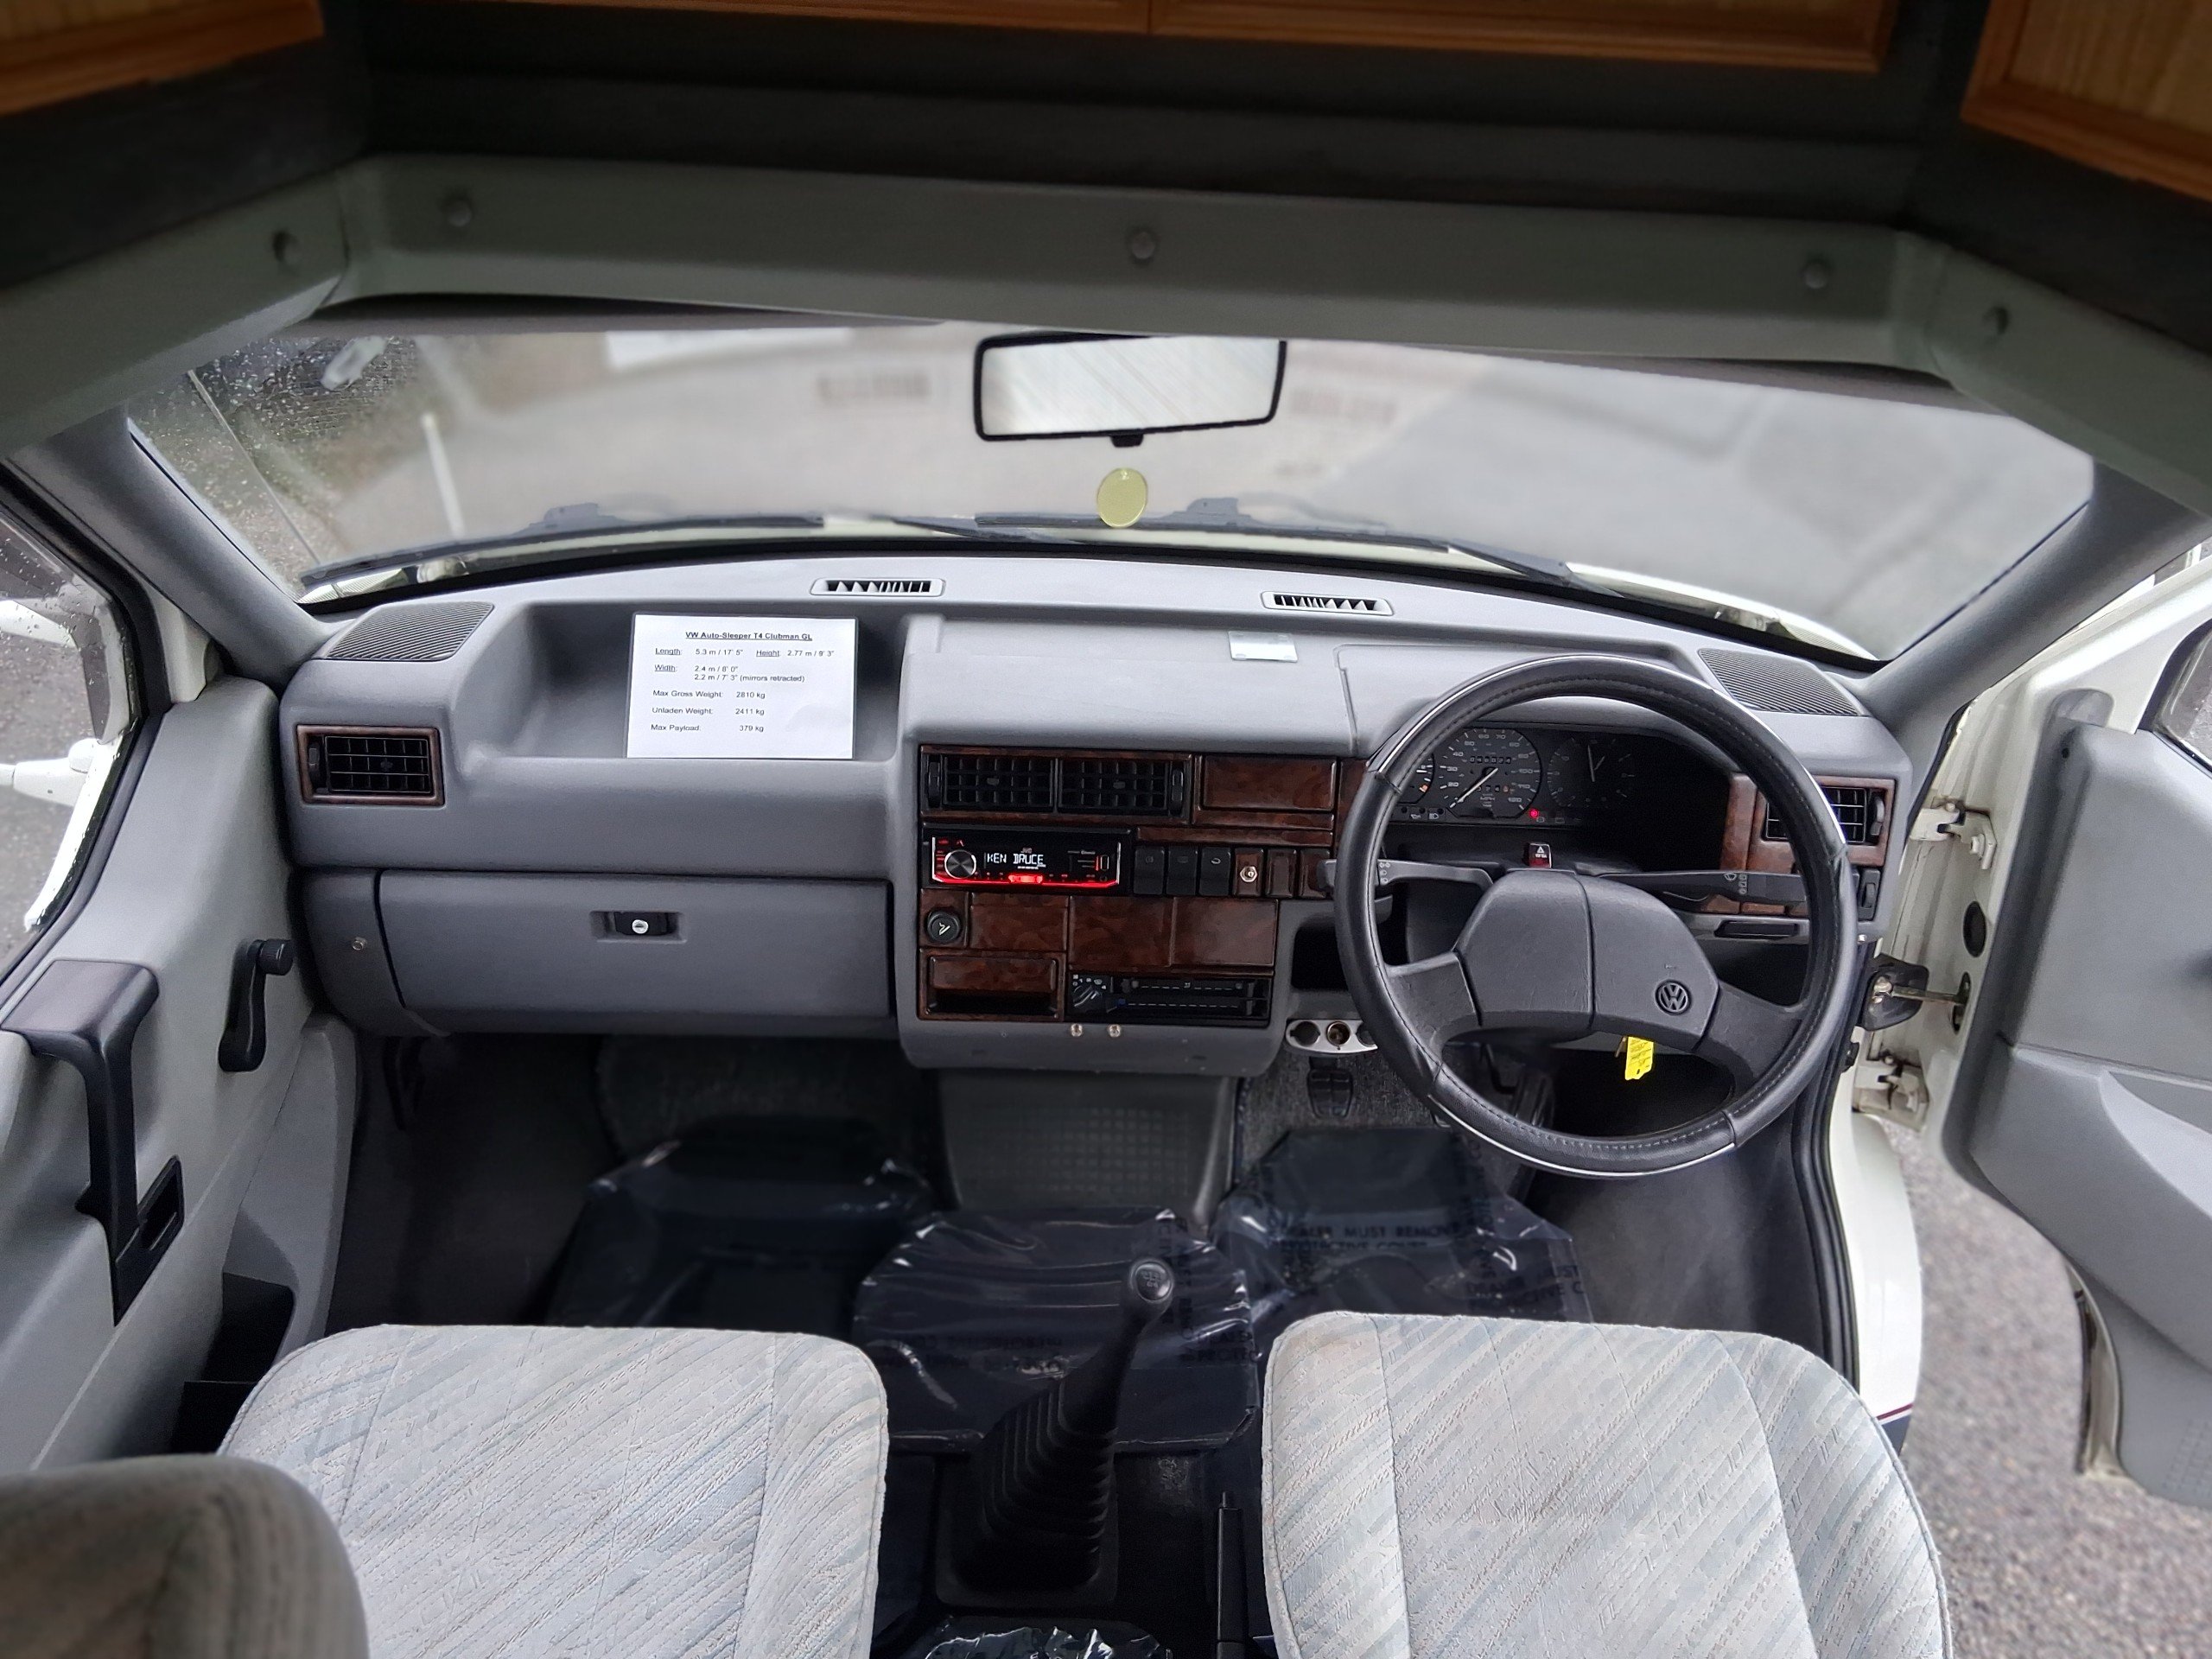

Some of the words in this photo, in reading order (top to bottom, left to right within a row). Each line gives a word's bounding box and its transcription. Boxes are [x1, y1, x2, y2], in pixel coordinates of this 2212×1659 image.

[701, 632, 752, 640] Auto-Sleeper
[770, 675, 805, 683] retracted)
[986, 852, 1007, 864] KEN
